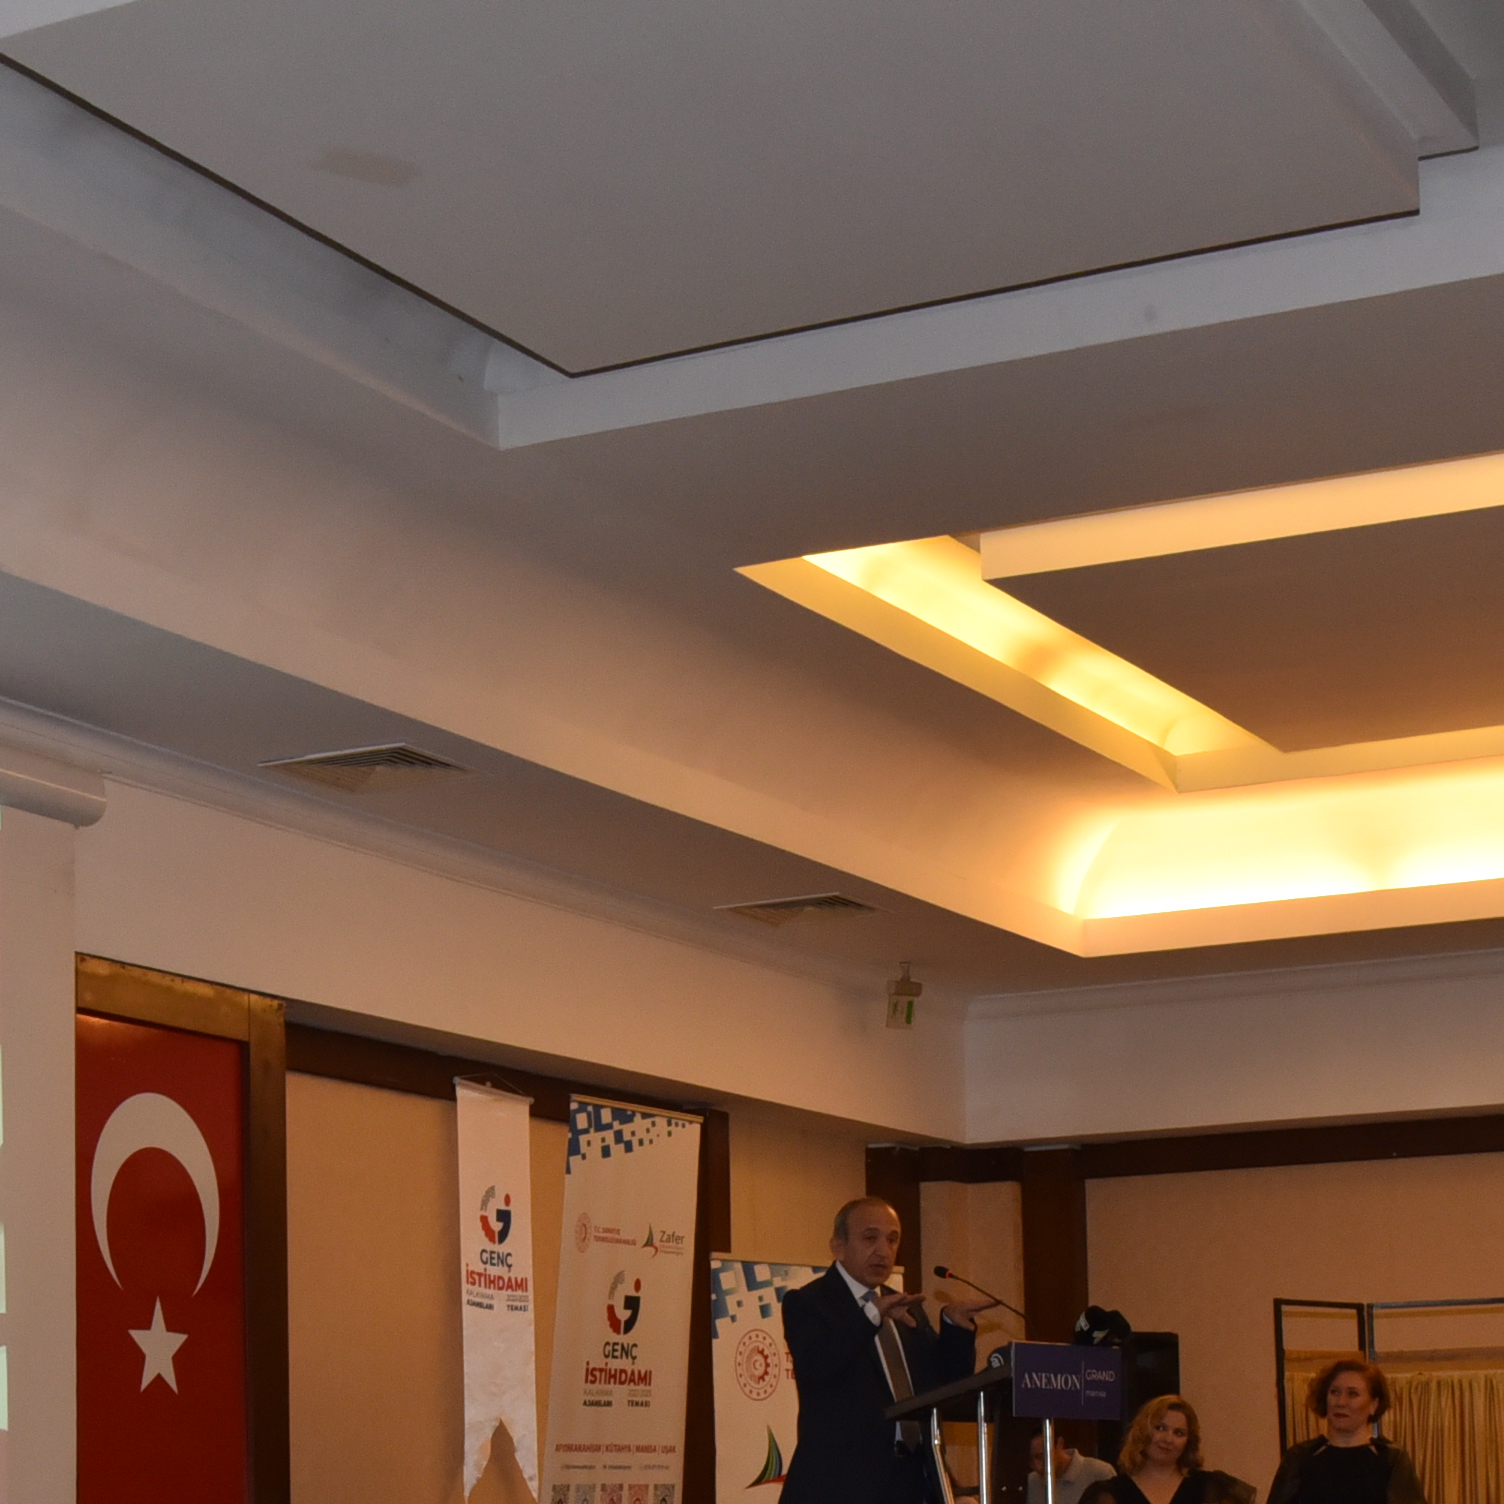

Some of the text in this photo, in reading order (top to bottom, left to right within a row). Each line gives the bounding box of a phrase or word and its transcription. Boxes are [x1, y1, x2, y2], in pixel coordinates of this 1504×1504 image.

[659, 1230, 685, 1244] Zafer
[480, 1248, 513, 1273] GENÇ
[465, 1262, 528, 1293] İSTİHDAMI
[603, 1341, 638, 1365] GENÇ
[584, 1360, 653, 1387] İSTİHDAMI
[1021, 1369, 1116, 1391] ANEMON GRAND
